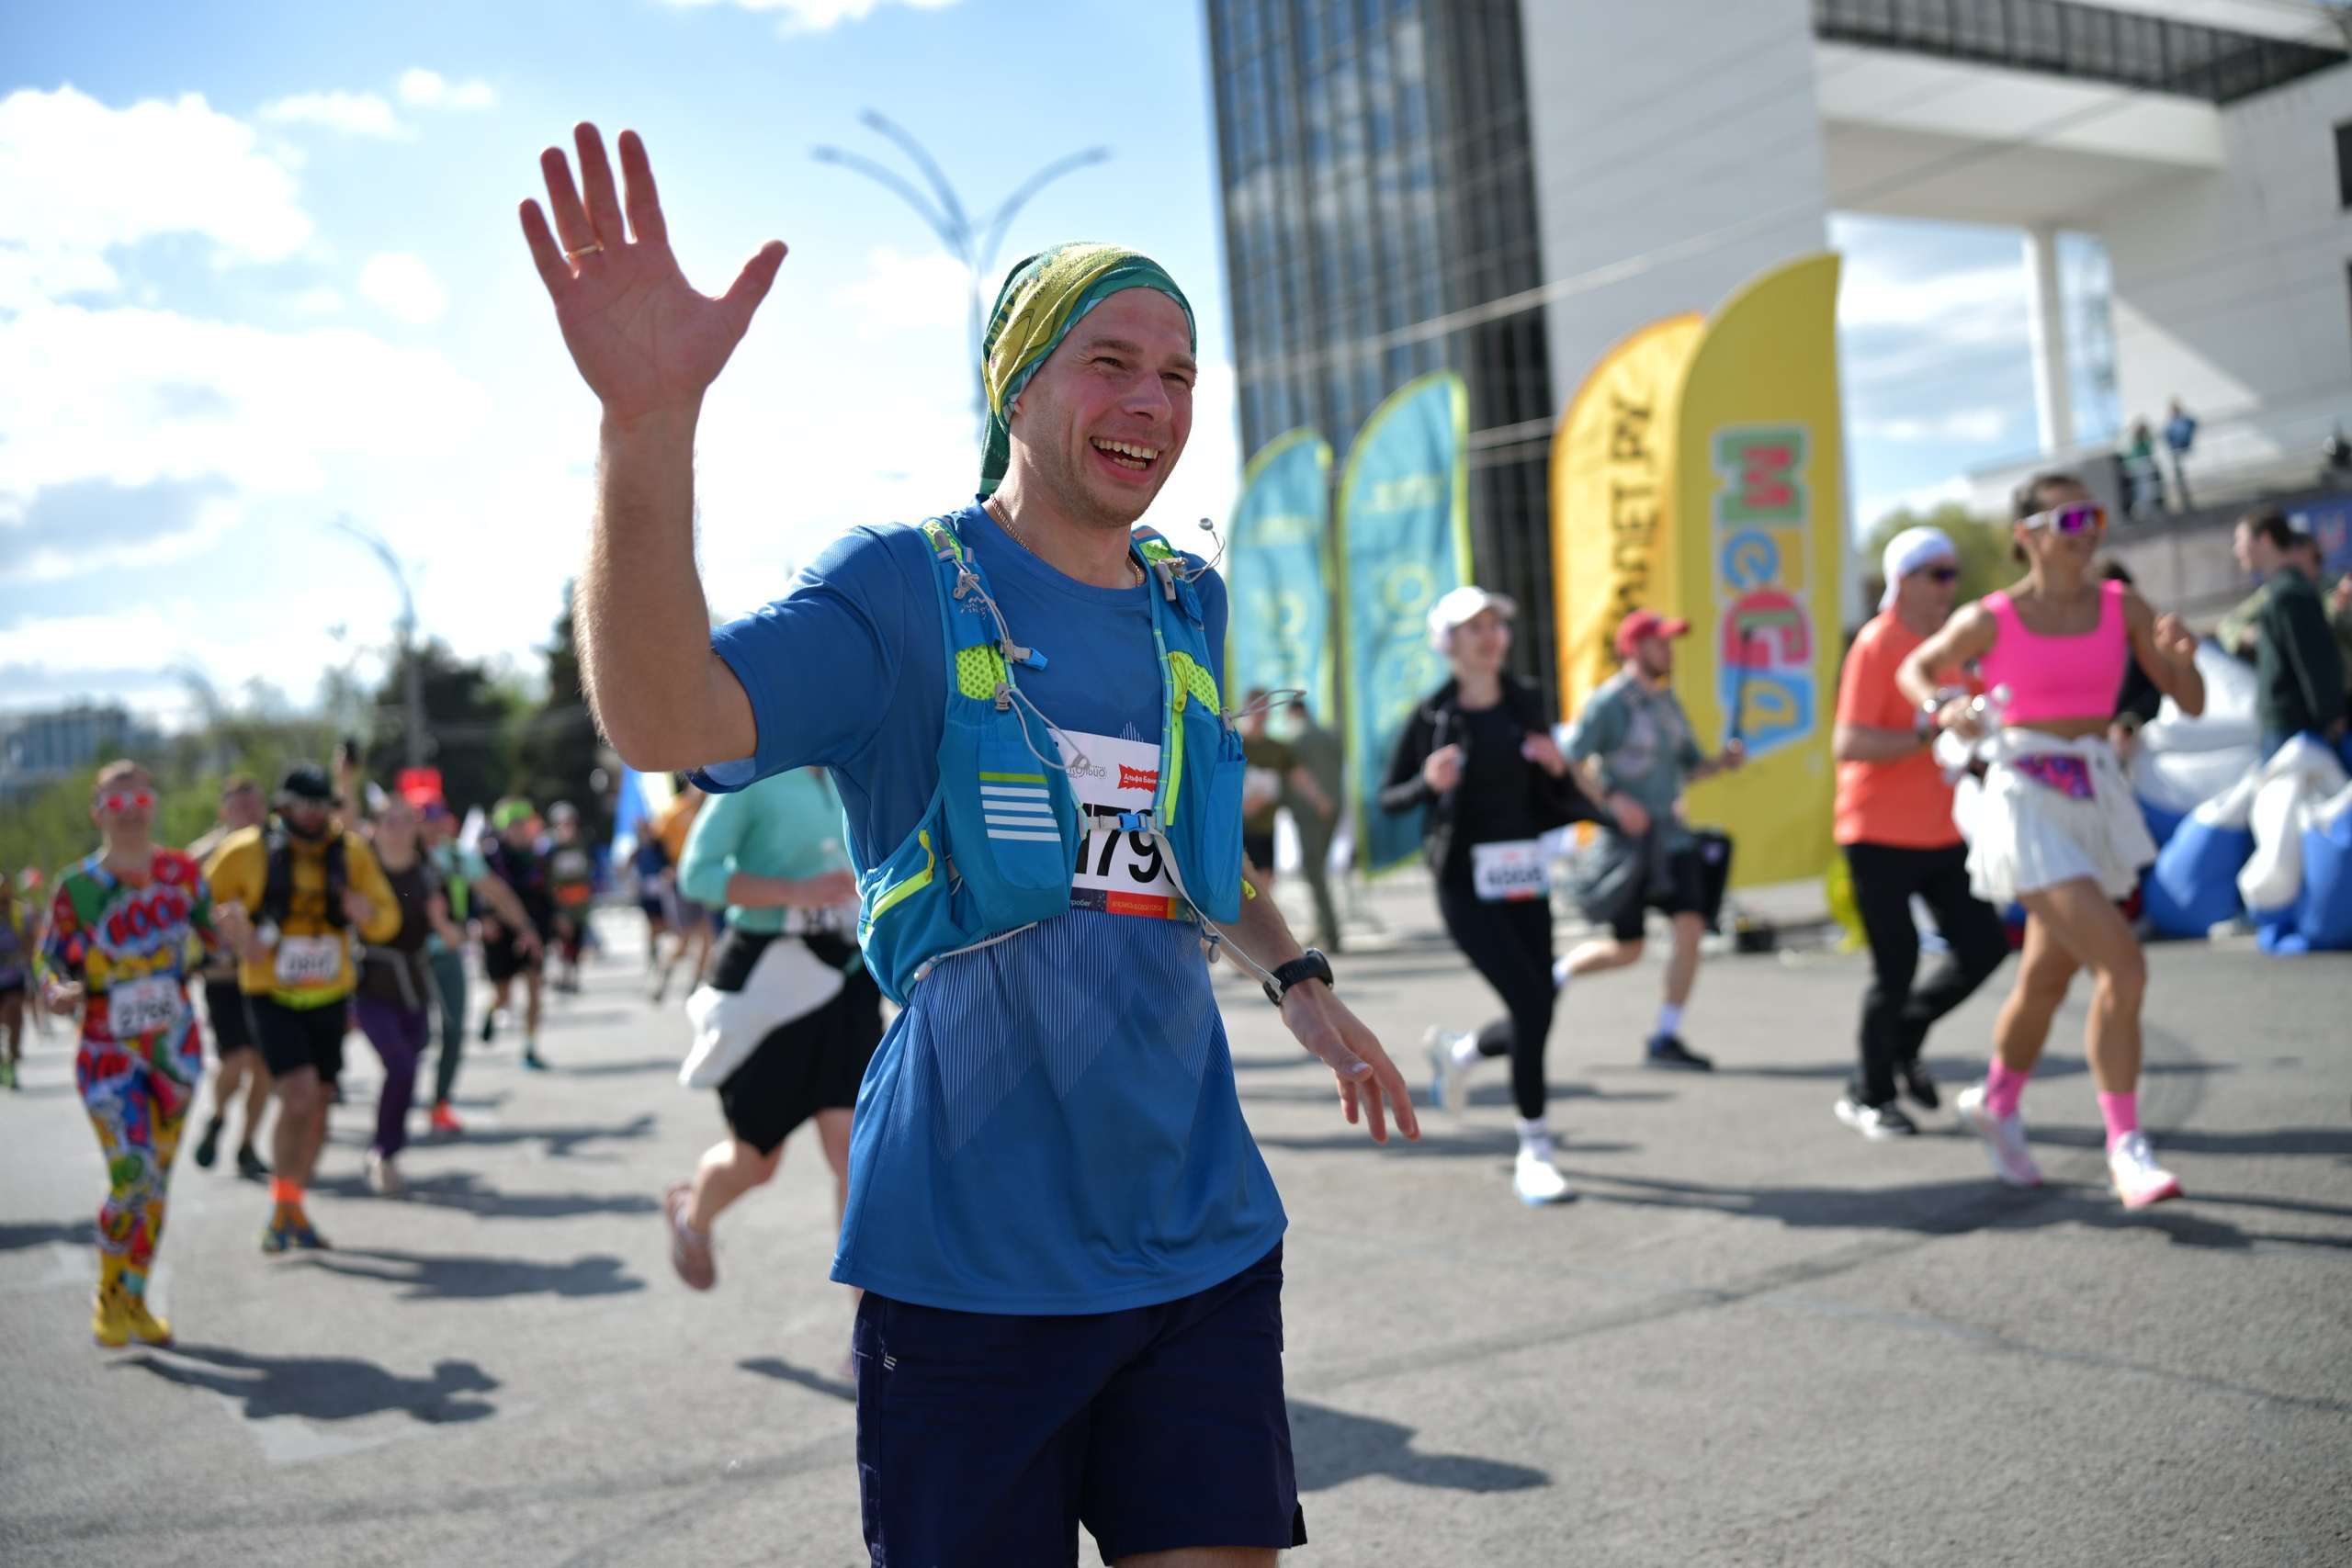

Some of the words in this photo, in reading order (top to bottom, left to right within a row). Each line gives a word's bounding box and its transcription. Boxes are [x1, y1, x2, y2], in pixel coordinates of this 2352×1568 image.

[1124, 773, 1142, 784] Альфа
[1143, 775, 1158, 784] Банк
[1074, 802, 1177, 886] 179
